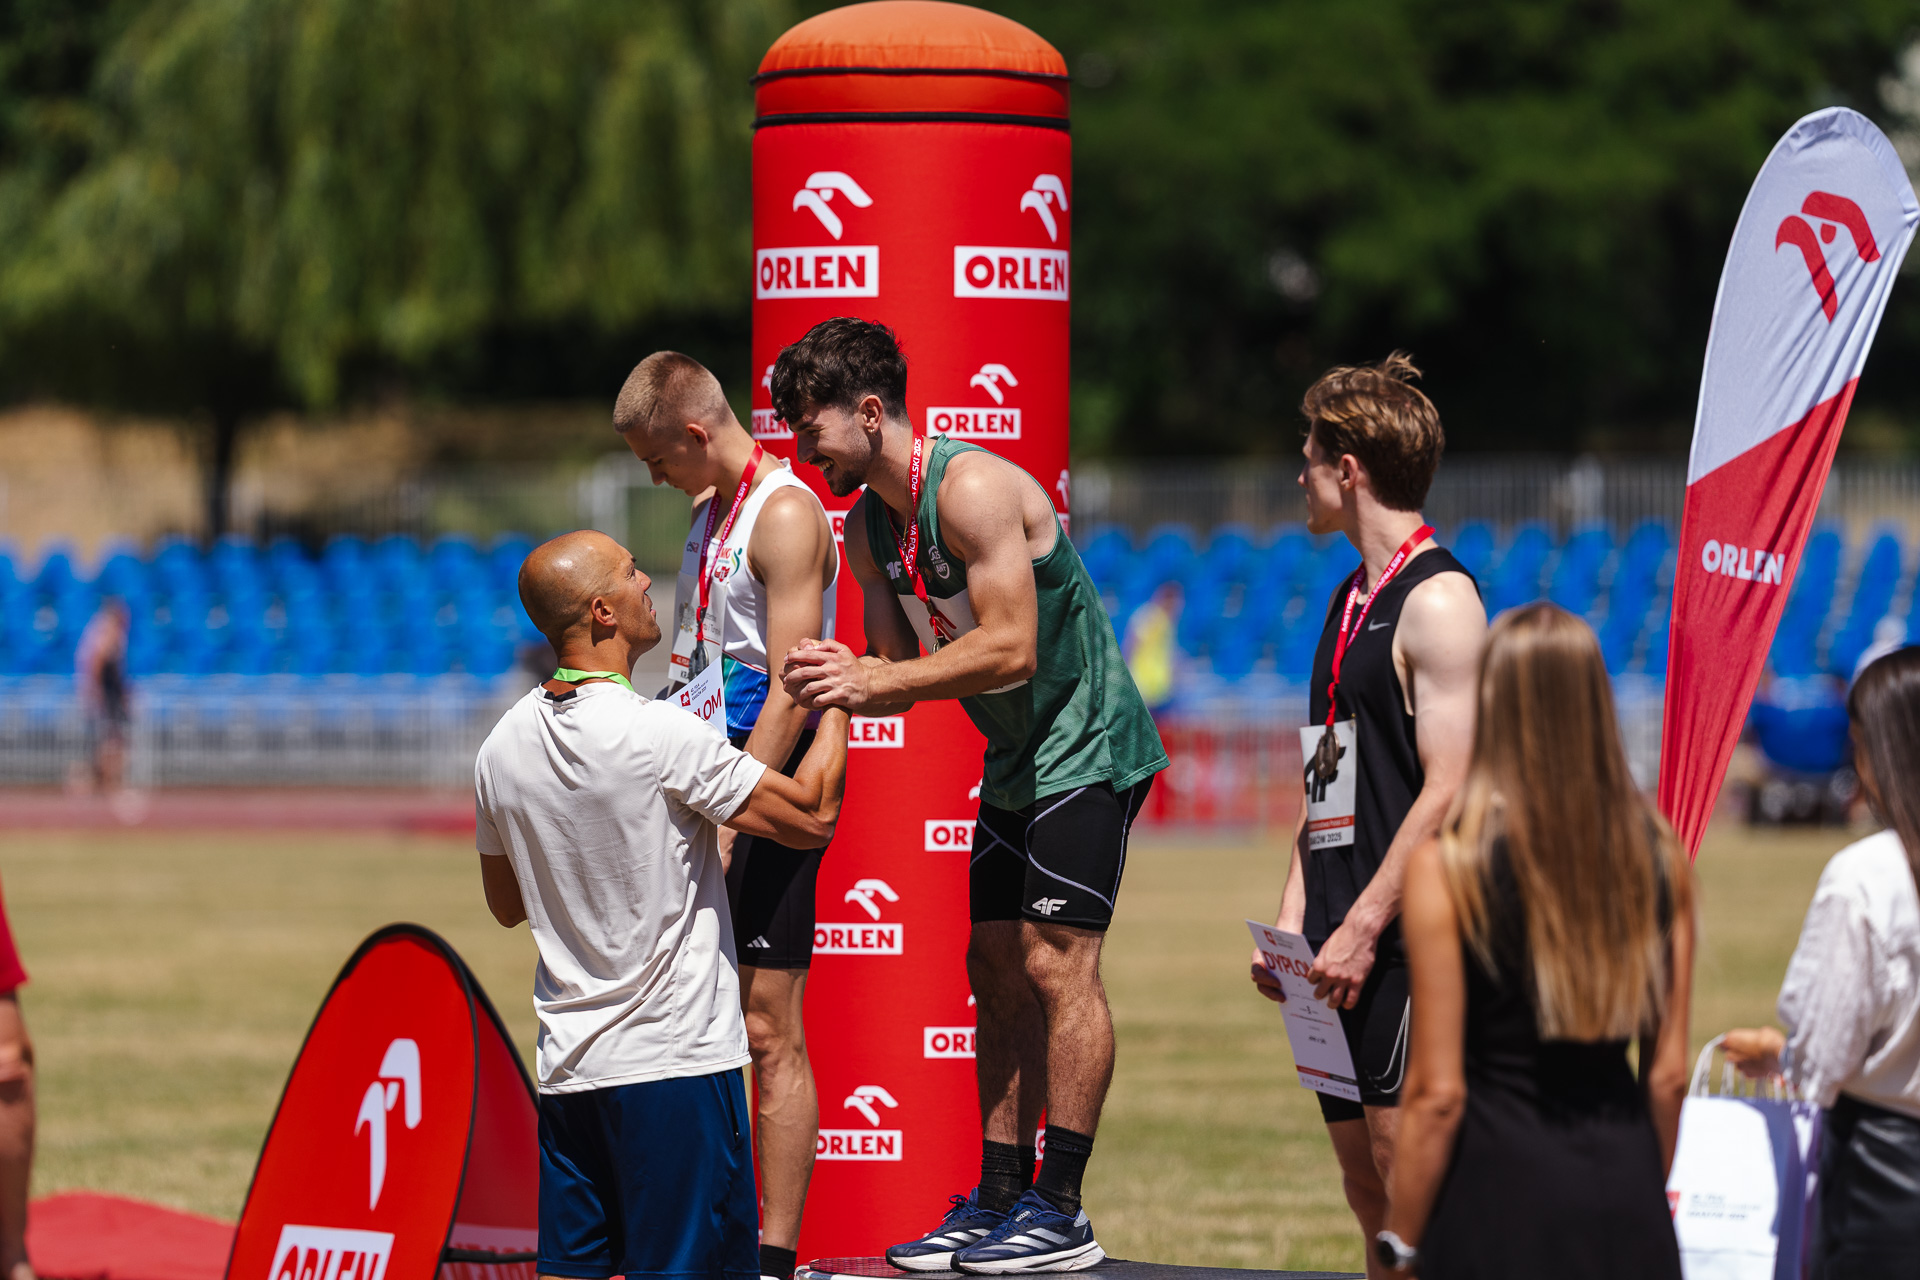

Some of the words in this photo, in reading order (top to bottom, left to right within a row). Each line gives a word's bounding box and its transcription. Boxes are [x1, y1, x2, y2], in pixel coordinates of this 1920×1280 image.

[760, 254, 866, 290] ORLEN
[965, 254, 1066, 292] ORLEN
[933, 412, 1016, 434] ORLEN
[913, 438, 922, 457] 2025
[911, 457, 920, 491] POLSKI
[1701, 539, 1785, 586] ORLEN
[848, 722, 896, 741] LEN
[1032, 897, 1067, 915] 4F
[813, 928, 895, 949] ORLEN
[1261, 950, 1314, 979] DYPLO
[816, 1135, 894, 1155] ORLEN
